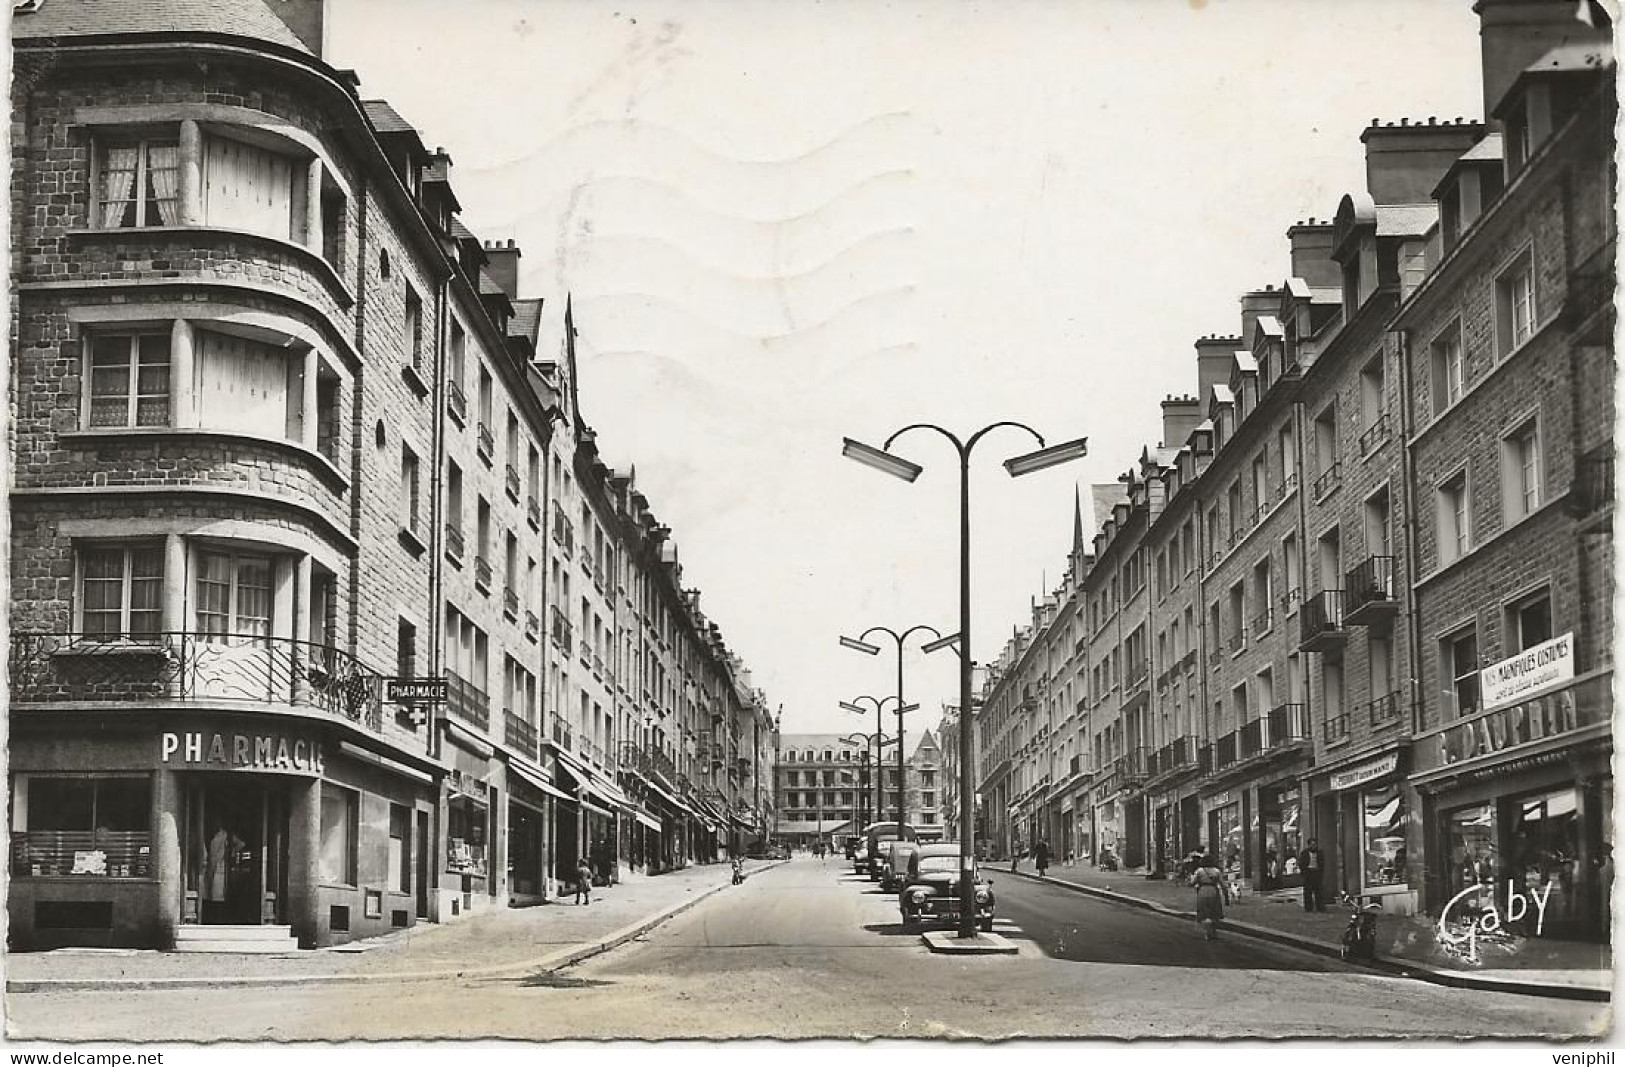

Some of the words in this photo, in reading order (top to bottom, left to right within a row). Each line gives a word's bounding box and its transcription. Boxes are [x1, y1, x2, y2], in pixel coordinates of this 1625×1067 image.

[390, 685, 445, 698] PHARMACIE
[1462, 689, 1577, 761] DAUPHIN
[161, 731, 325, 774] PHARMACIE
